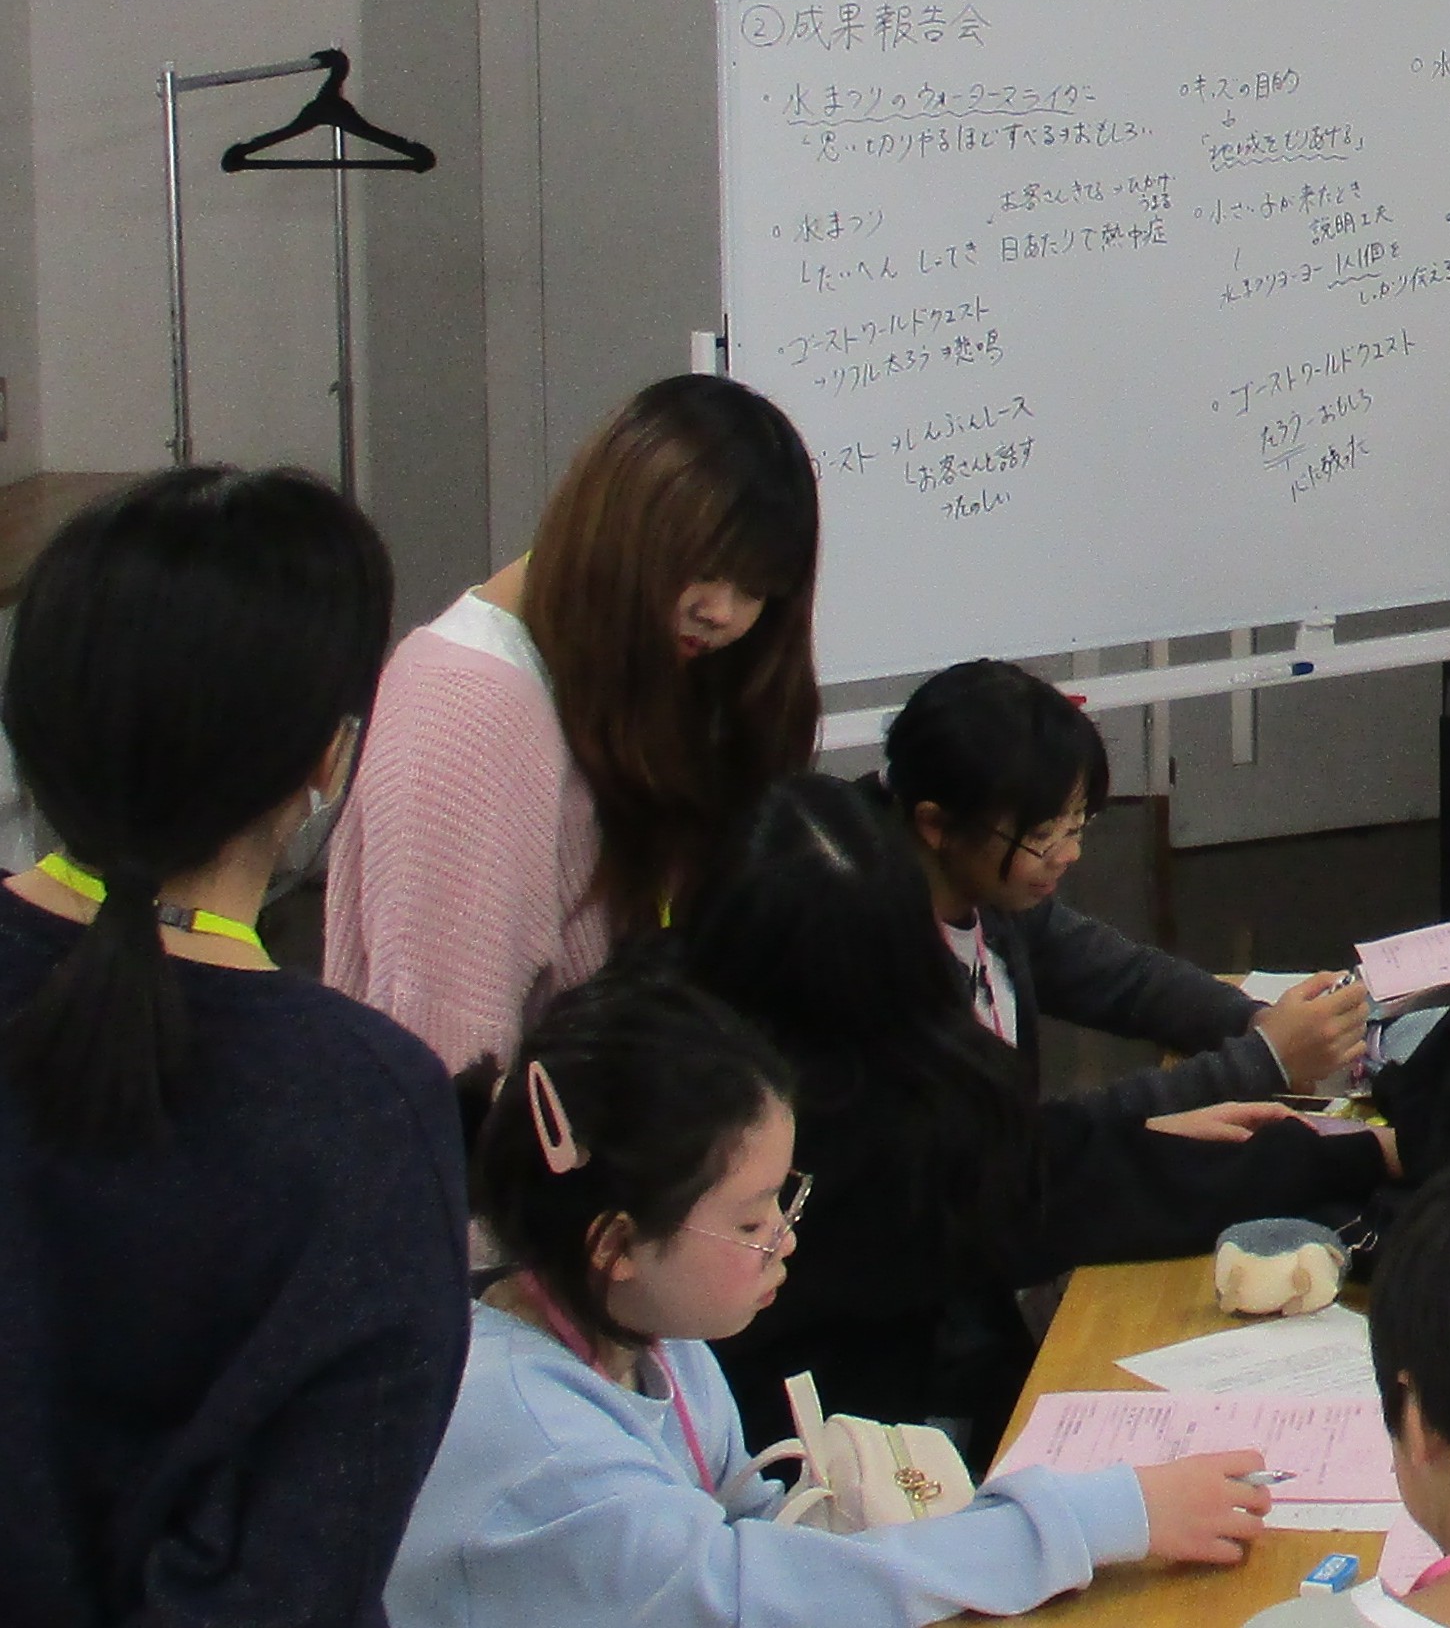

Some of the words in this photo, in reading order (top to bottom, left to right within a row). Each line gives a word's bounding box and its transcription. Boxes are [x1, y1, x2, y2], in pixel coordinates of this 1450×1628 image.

[1193, 66, 1301, 104] キッズの目的
[793, 209, 885, 244] 水まつり
[787, 295, 991, 366] ゴーストワールドクエスト
[1229, 327, 1416, 417] ゴーストワールドクエスト
